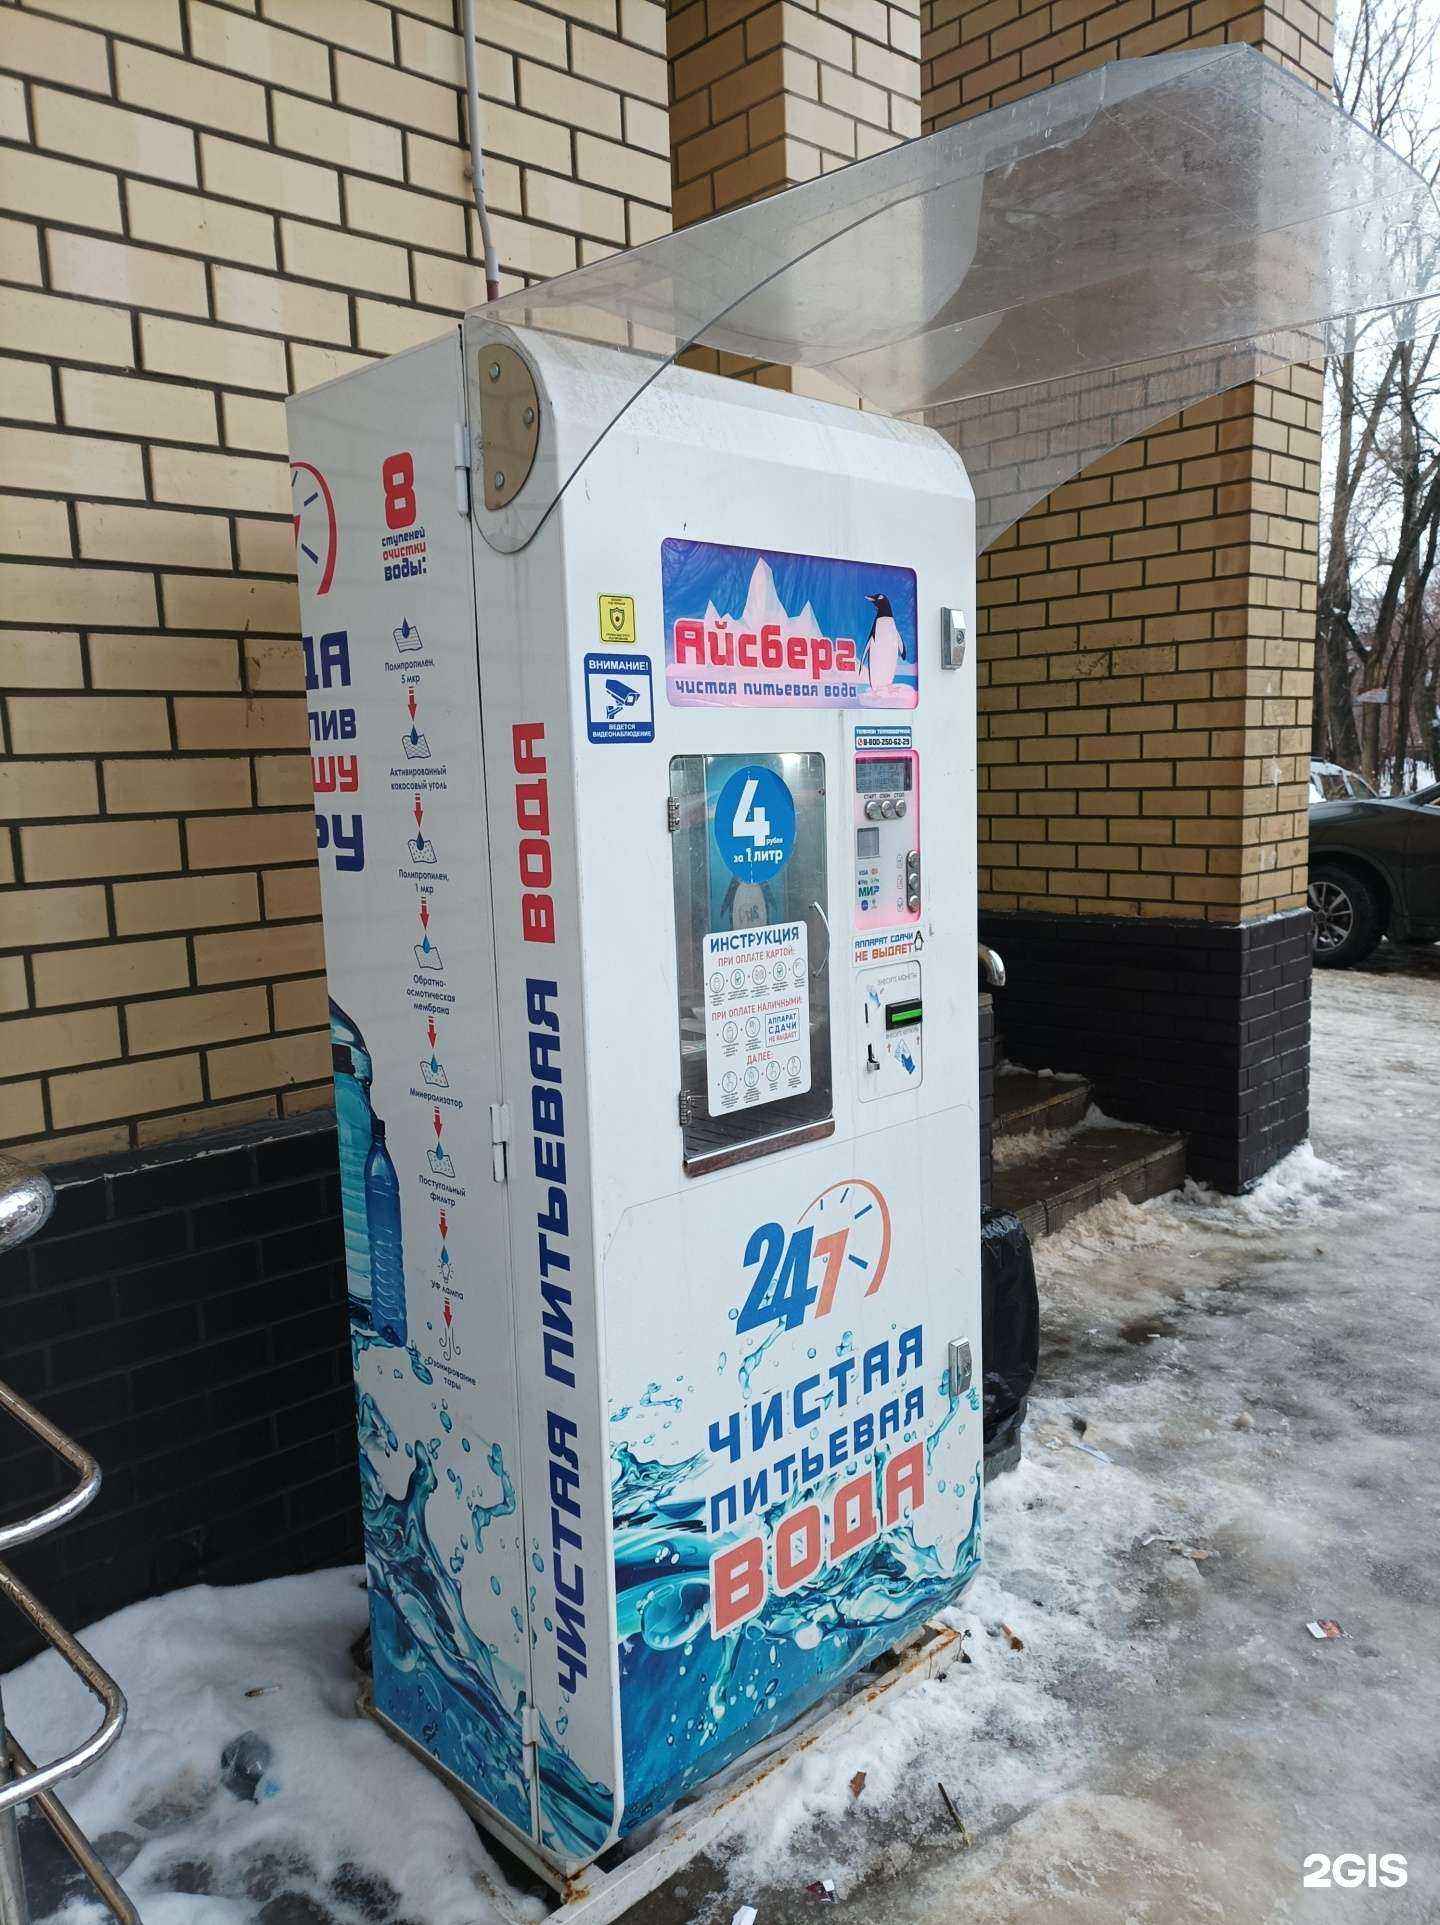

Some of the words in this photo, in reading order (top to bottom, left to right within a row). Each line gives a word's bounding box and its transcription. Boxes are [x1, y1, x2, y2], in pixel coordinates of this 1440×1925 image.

[382, 452, 416, 530] 8
[382, 527, 426, 547] ступеней
[383, 542, 426, 561] очистки
[384, 557, 427, 581] воды:
[675, 620, 856, 680] Айсберг
[589, 660, 649, 671] ВНИМАНИЕ!
[401, 674, 406, 683] 5
[675, 679, 737, 695] чистая
[743, 680, 818, 697] питьевая
[824, 681, 856, 697] вода
[592, 730, 652, 738] ВИДЕОНАБЛЮДЕНИЕ
[390, 764, 447, 777] Активированный
[391, 780, 427, 790] кокосовый
[733, 780, 770, 846] 4
[512, 722, 556, 944] ВОДА
[746, 848, 752, 862] 1
[710, 927, 799, 953] ИНСТРУКЦИЯ
[855, 936, 888, 949] АППАРАТ
[891, 932, 913, 943] СДАЧИ
[736, 951, 764, 964] ОПЛАТЕ
[855, 950, 868, 962] НЕ
[872, 943, 914, 959] ВЫДАЕТ
[768, 1013, 796, 1025] АППАРАТ
[768, 1022, 797, 1034] СДАЧИ
[526, 978, 576, 1389] ПИТЬЕВАЯ
[708, 1325, 923, 1464] ЧИСТАЯ
[711, 1385, 924, 1533] ПИТЬЕВАЯ
[713, 1442, 924, 1633] ВОДА
[547, 1409, 588, 1695] ЧИСТАЯ
